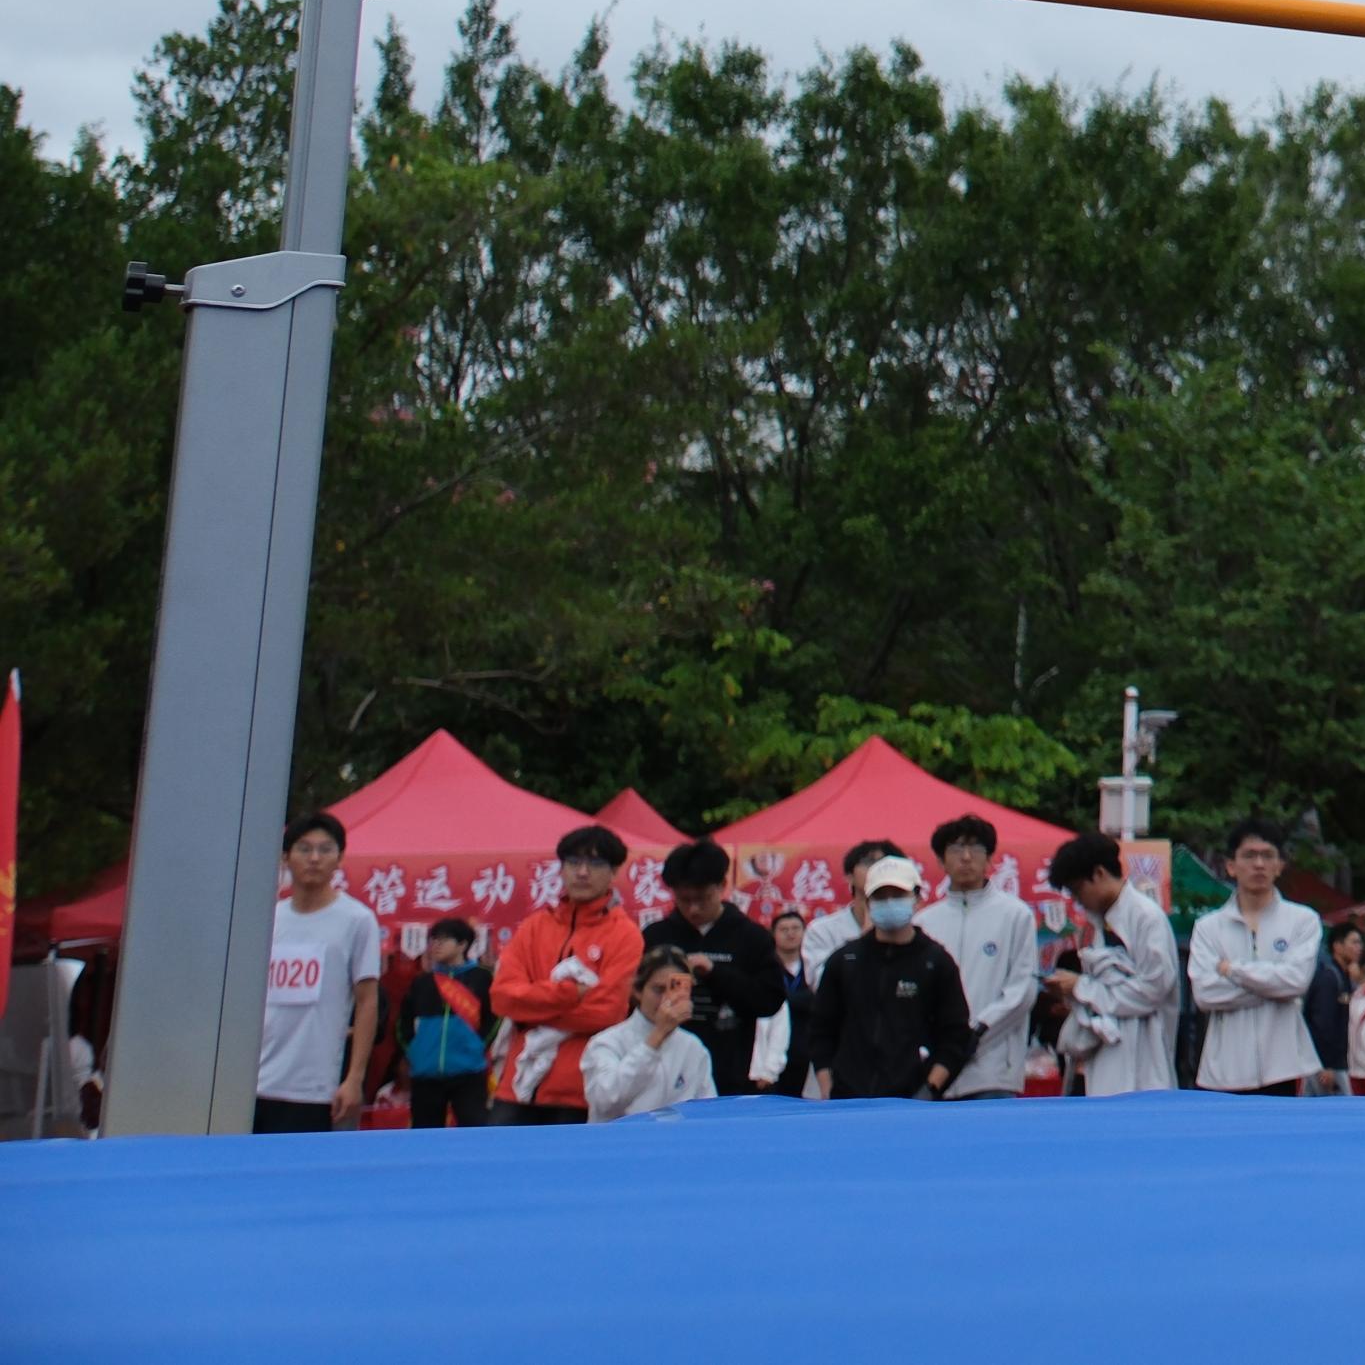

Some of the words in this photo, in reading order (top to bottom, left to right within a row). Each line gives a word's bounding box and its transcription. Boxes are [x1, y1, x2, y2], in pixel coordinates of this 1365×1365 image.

[330, 858, 673, 915] 管运动员家
[269, 957, 320, 989] 1020
